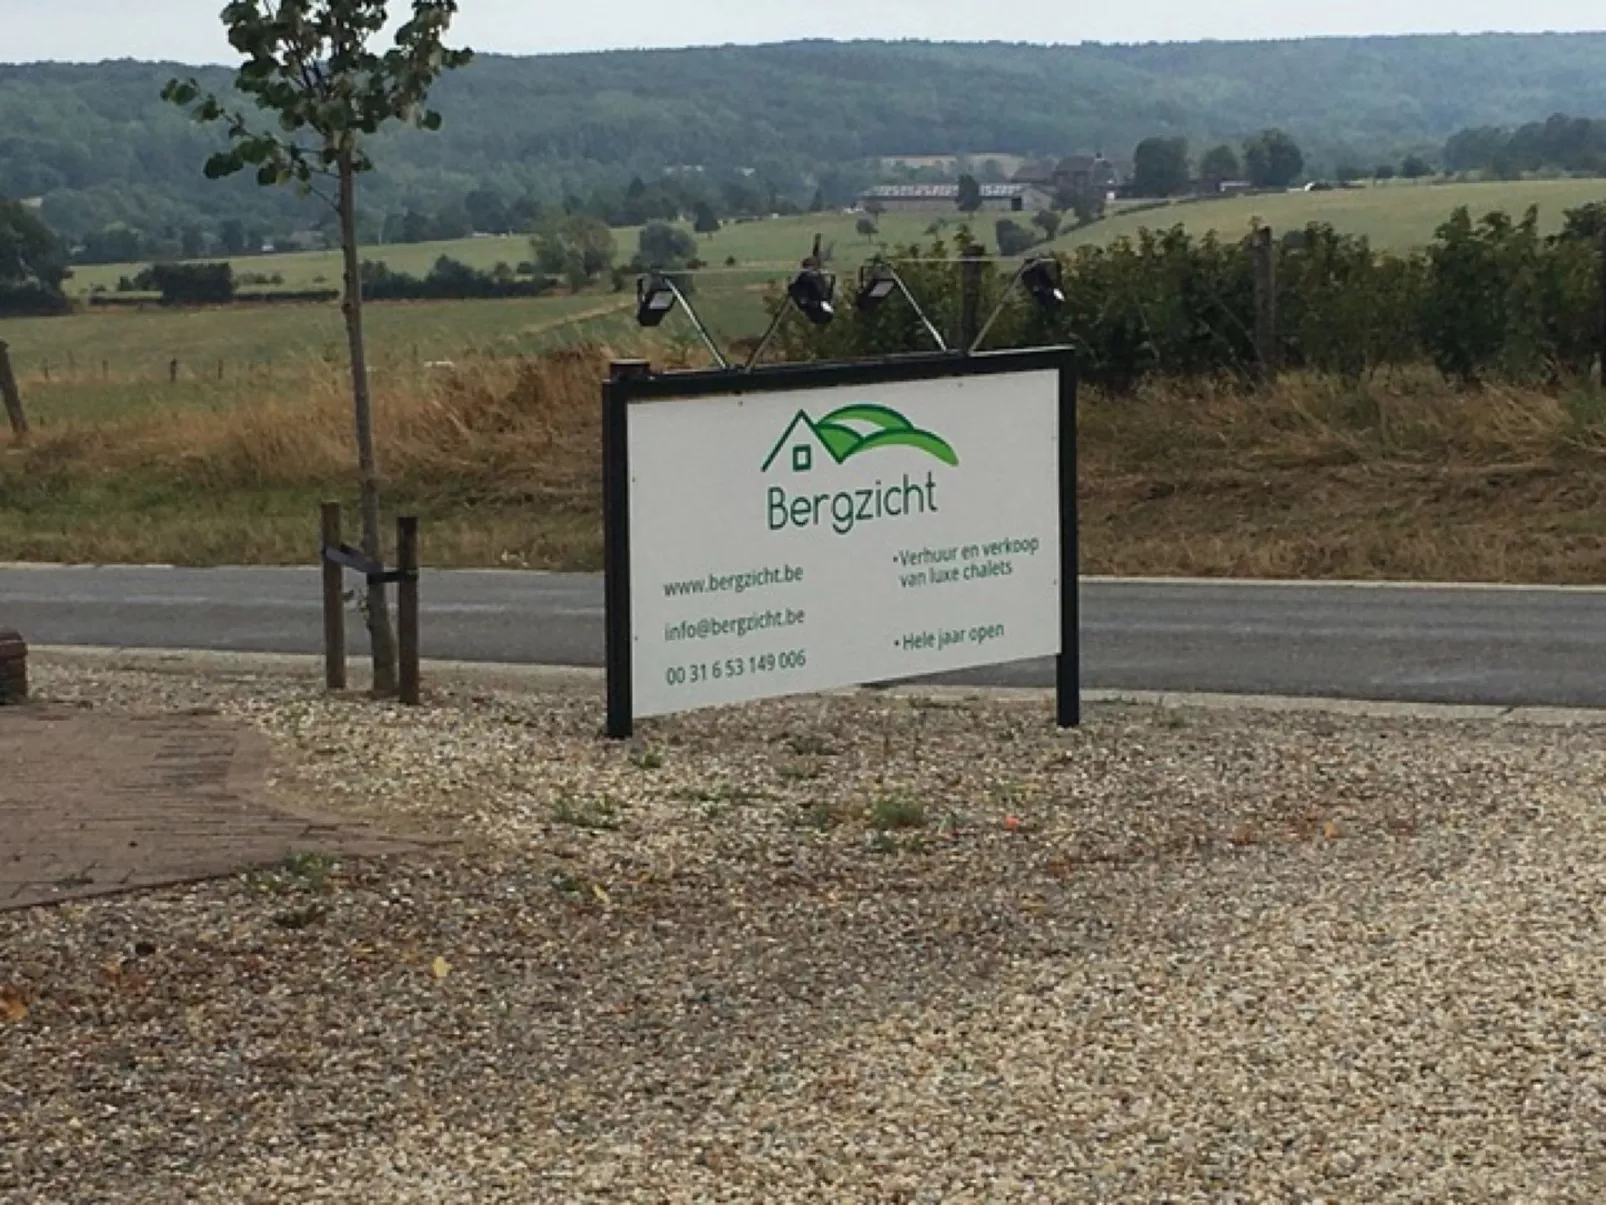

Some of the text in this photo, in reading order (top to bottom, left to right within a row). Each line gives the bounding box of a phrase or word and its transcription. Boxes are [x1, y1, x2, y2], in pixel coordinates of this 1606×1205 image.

[767, 470, 938, 535] Bergzicht
[899, 537, 1039, 567] Verhuur en verkoop
[663, 564, 804, 597] www.bergzicht.be
[899, 560, 1013, 588] van luxe chalets
[664, 608, 805, 641] info@bergzicht.be
[903, 623, 1005, 651] Hele jaar open
[666, 649, 806, 686] 00 31 6 53 149 006
